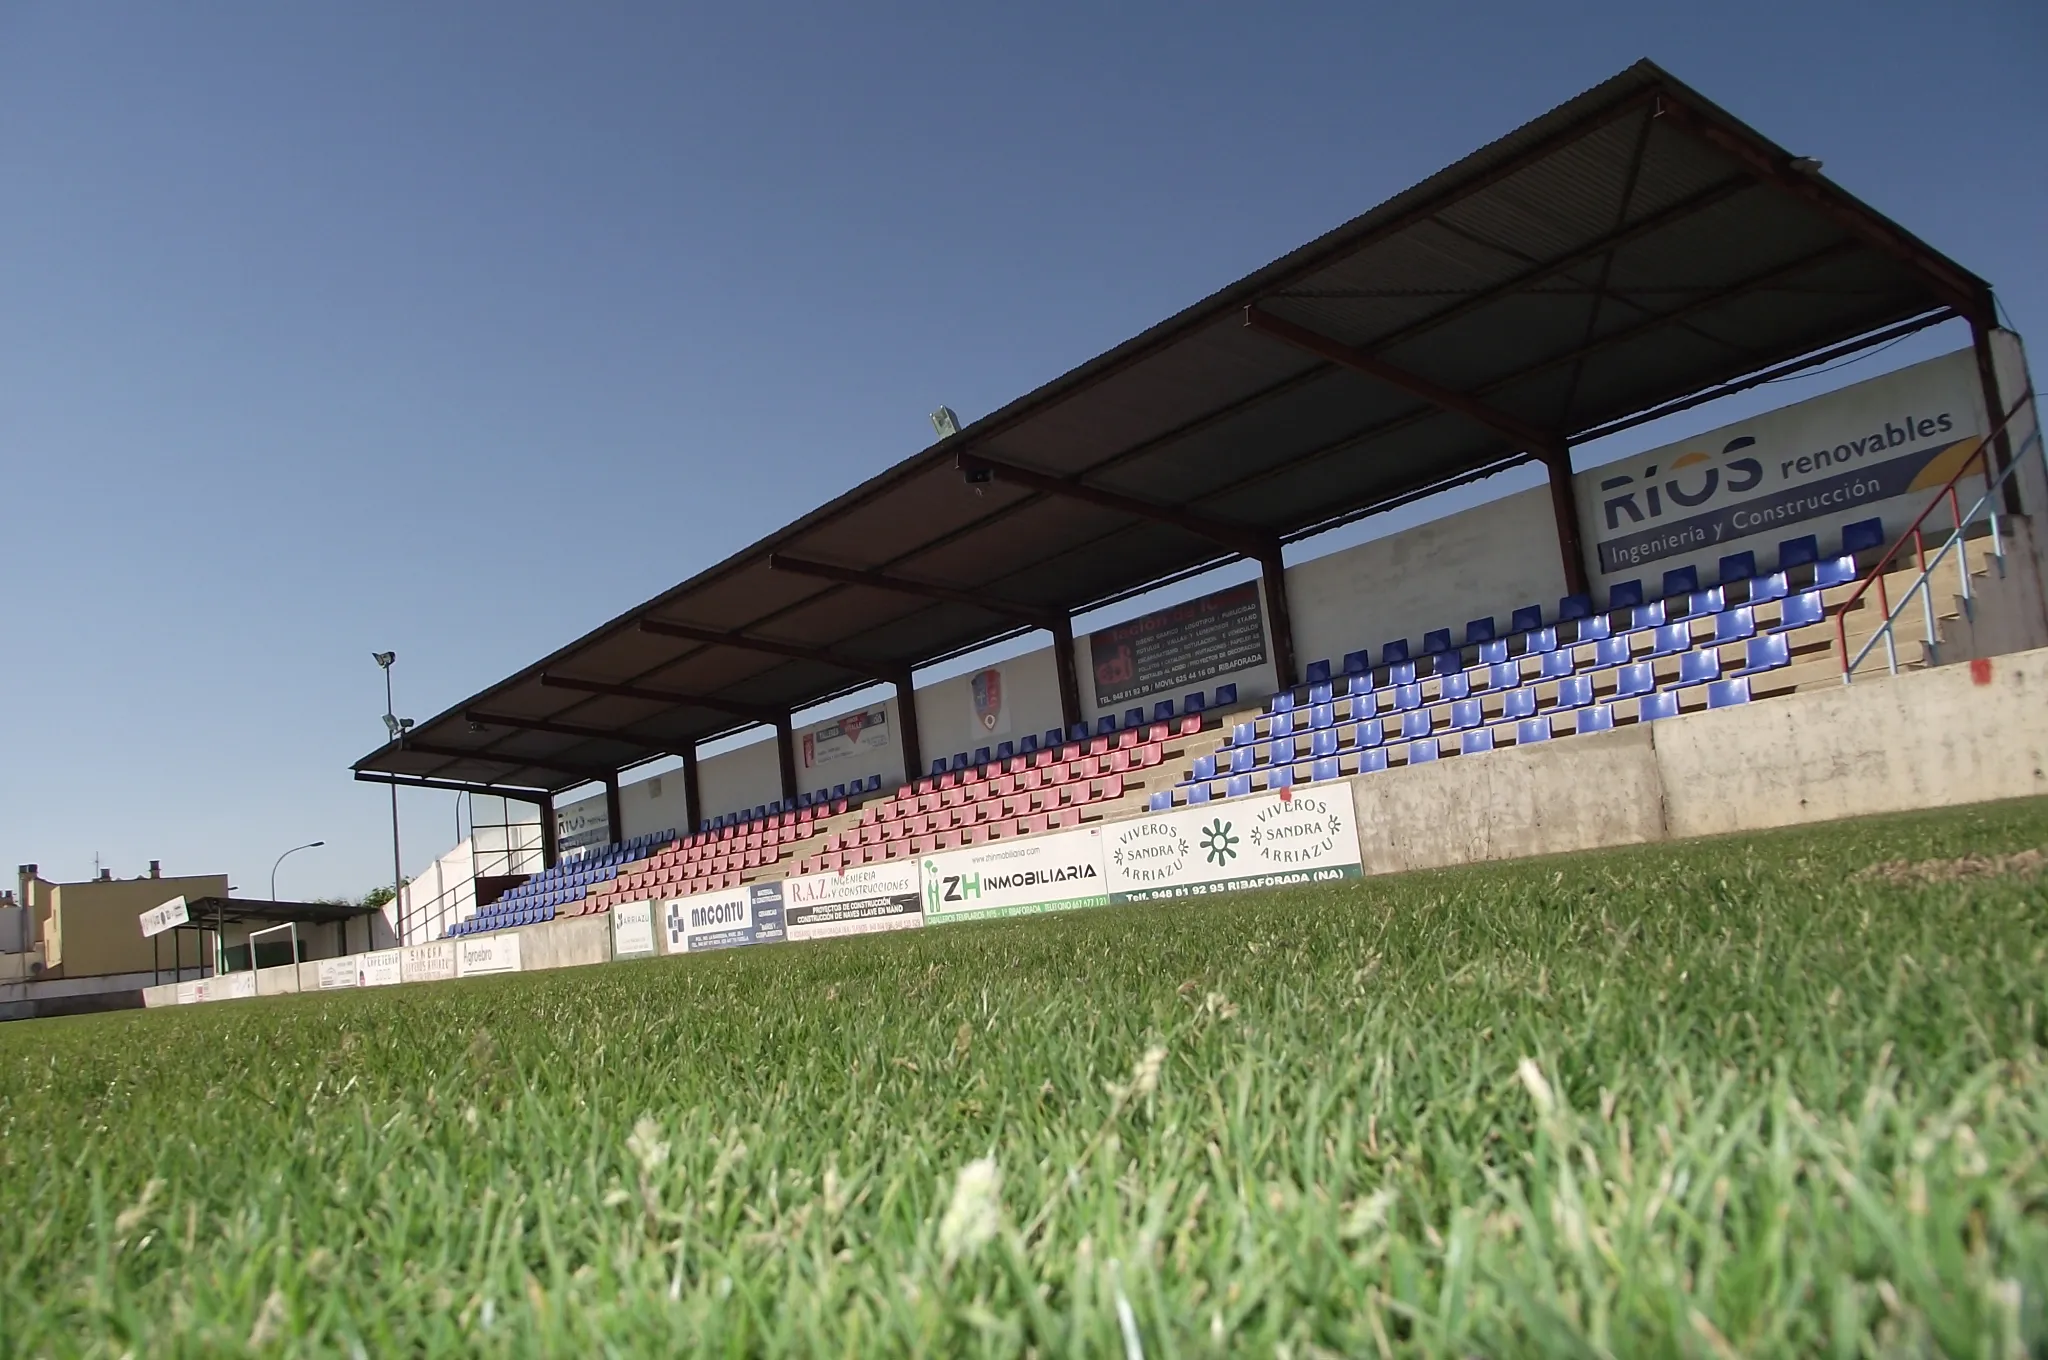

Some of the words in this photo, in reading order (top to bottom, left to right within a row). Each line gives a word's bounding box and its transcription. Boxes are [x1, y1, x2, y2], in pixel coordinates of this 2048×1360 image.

[1601, 436, 1764, 530] RÍOS
[1781, 411, 1954, 480] renovables
[1611, 525, 1707, 565] Ingeniería
[1713, 521, 1725, 541] y
[1732, 476, 1881, 531] Construcción
[1184, 616, 1215, 630] LOGOTIPOS
[1222, 603, 1256, 619] PUBLICIDAD
[1237, 613, 1258, 624] STAND
[1228, 623, 1259, 637] VEHICULOS
[1227, 642, 1261, 656] DECORACION
[1154, 678, 1175, 689] MOVIL
[1188, 671, 1197, 680] 44
[1218, 653, 1263, 672] RIBAFORADA
[1257, 798, 1327, 823] VIVEROS
[1119, 823, 1177, 845] VIVEROS
[1266, 821, 1323, 841] SANDRA
[1127, 844, 1174, 861] SANDRA
[1260, 837, 1333, 863] ARRIAZU
[831, 870, 876, 886] INGENIERIA
[1121, 858, 1183, 881] ARRIAZU
[791, 878, 831, 903] R.A.Z.
[831, 890, 837, 898] Y
[838, 878, 909, 898] CONSTRUCCIONES
[942, 871, 981, 902] ZH
[983, 863, 1098, 891] INMOBILIARIA
[1126, 892, 1149, 902] Telf.
[1151, 889, 1173, 900] 948
[1175, 887, 1189, 897] 81
[1192, 885, 1207, 895] 92
[1209, 882, 1224, 893] 95
[1227, 873, 1310, 891] RIBAFORADA
[1313, 868, 1344, 882] (NA)
[691, 900, 744, 928] MACONTU
[812, 903, 842, 914] PROYECTOS
[842, 902, 850, 911] DE
[834, 911, 842, 920] DE
[843, 909, 860, 919] NAVES
[860, 907, 878, 917] LLAVE
[878, 906, 886, 915] EN
[886, 904, 904, 914] MANO
[1008, 904, 1042, 916] RIBAFORADA
[1044, 901, 1071, 912] TELEFONO
[1095, 897, 1107, 906] 121
[463, 942, 493, 966] Agroebro
